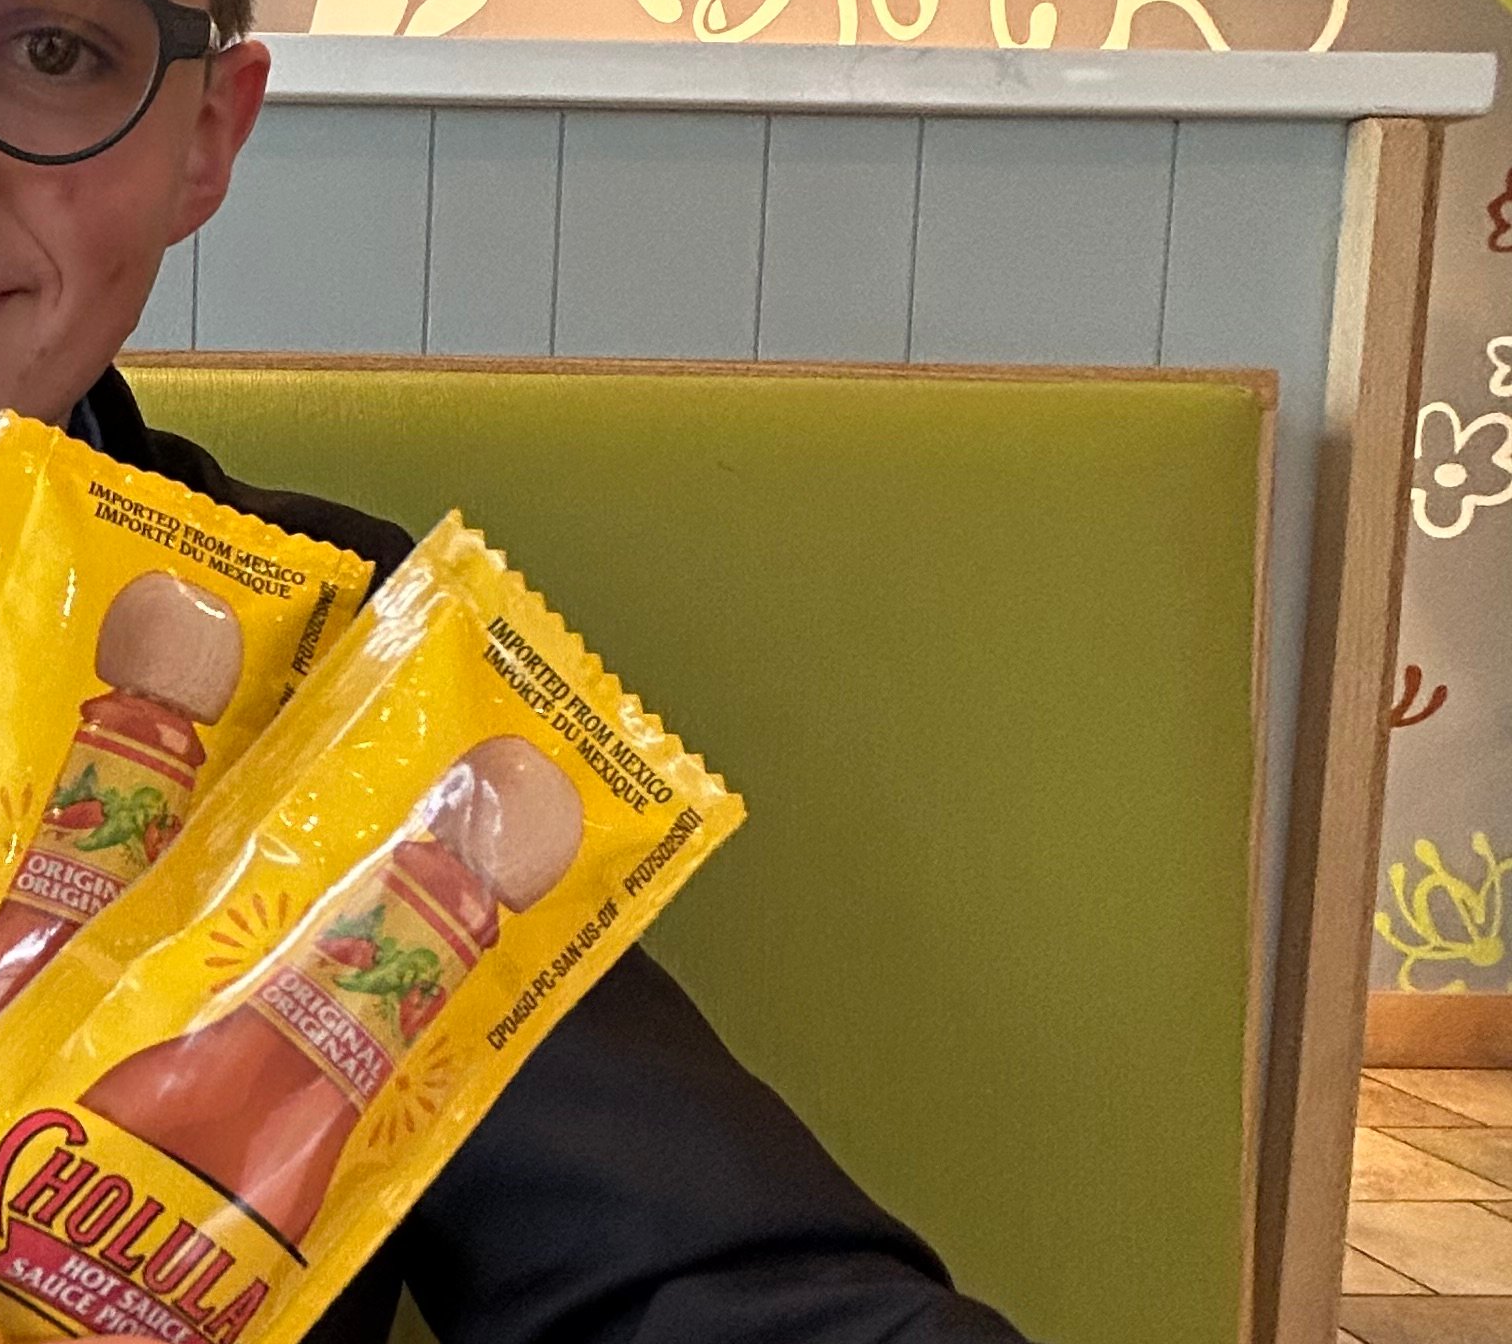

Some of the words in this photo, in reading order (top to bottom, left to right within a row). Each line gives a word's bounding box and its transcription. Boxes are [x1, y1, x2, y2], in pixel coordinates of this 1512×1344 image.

[88, 481, 181, 532] IMPORTED
[183, 523, 232, 558] FROM
[234, 544, 306, 587] MEXICO
[94, 502, 175, 549] IMPORTÉ
[178, 541, 204, 563] DU
[207, 555, 291, 600] MEXIQUE
[483, 644, 556, 720] IMPORTÉ
[550, 713, 582, 742] DU
[575, 736, 650, 816] MEXIQUE
[487, 616, 571, 701] IMPORTED
[568, 694, 614, 745] FROM
[609, 739, 674, 804] MEXICO
[15, 872, 104, 916] ORIGIN
[26, 854, 120, 900] ORIGIN
[260, 984, 375, 1097] ORIGINALE
[276, 972, 385, 1079] ORIGINAL
[6, 1257, 98, 1312] SAUCE
[58, 1255, 120, 1294] HOT
